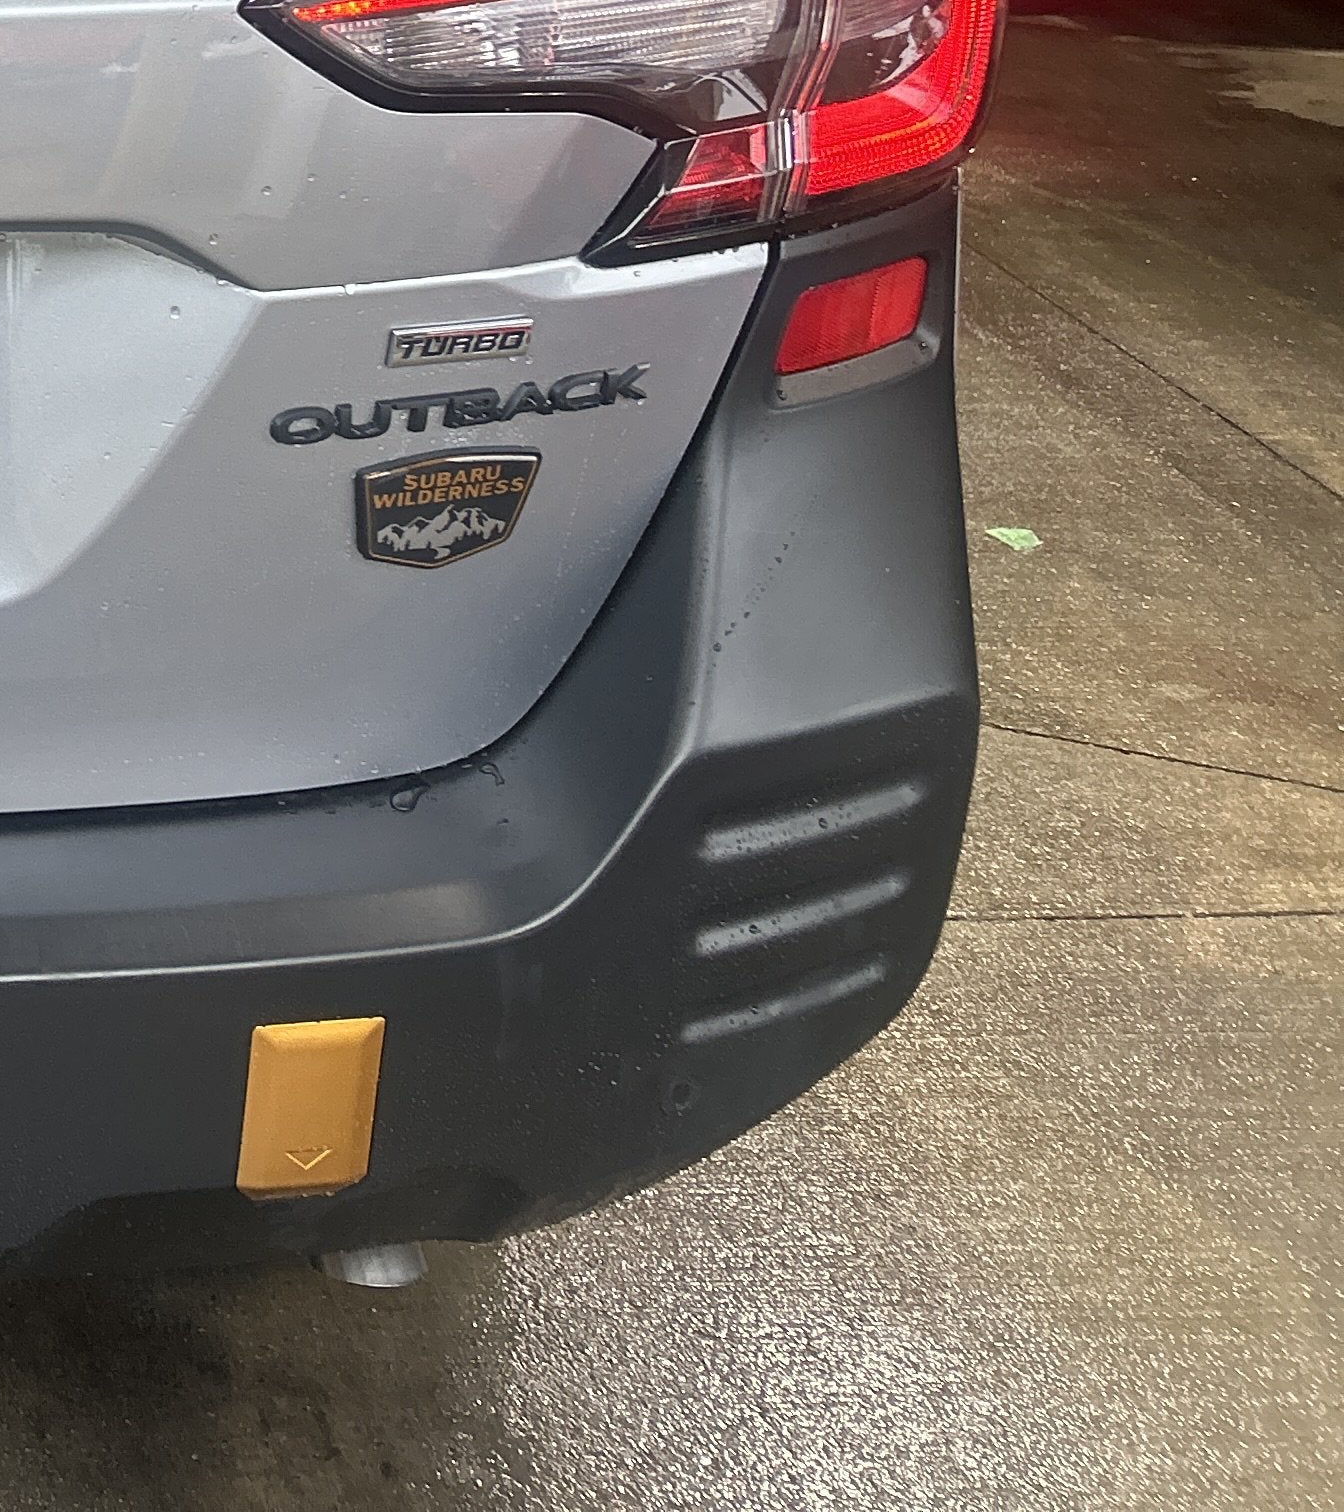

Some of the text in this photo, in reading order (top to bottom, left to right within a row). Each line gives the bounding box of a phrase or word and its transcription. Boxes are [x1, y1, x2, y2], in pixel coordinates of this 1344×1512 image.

[398, 330, 526, 360] TURBO
[269, 362, 651, 445] OUTBACK
[373, 476, 525, 509] WILDERNESS
[403, 463, 501, 492] SUBARU
